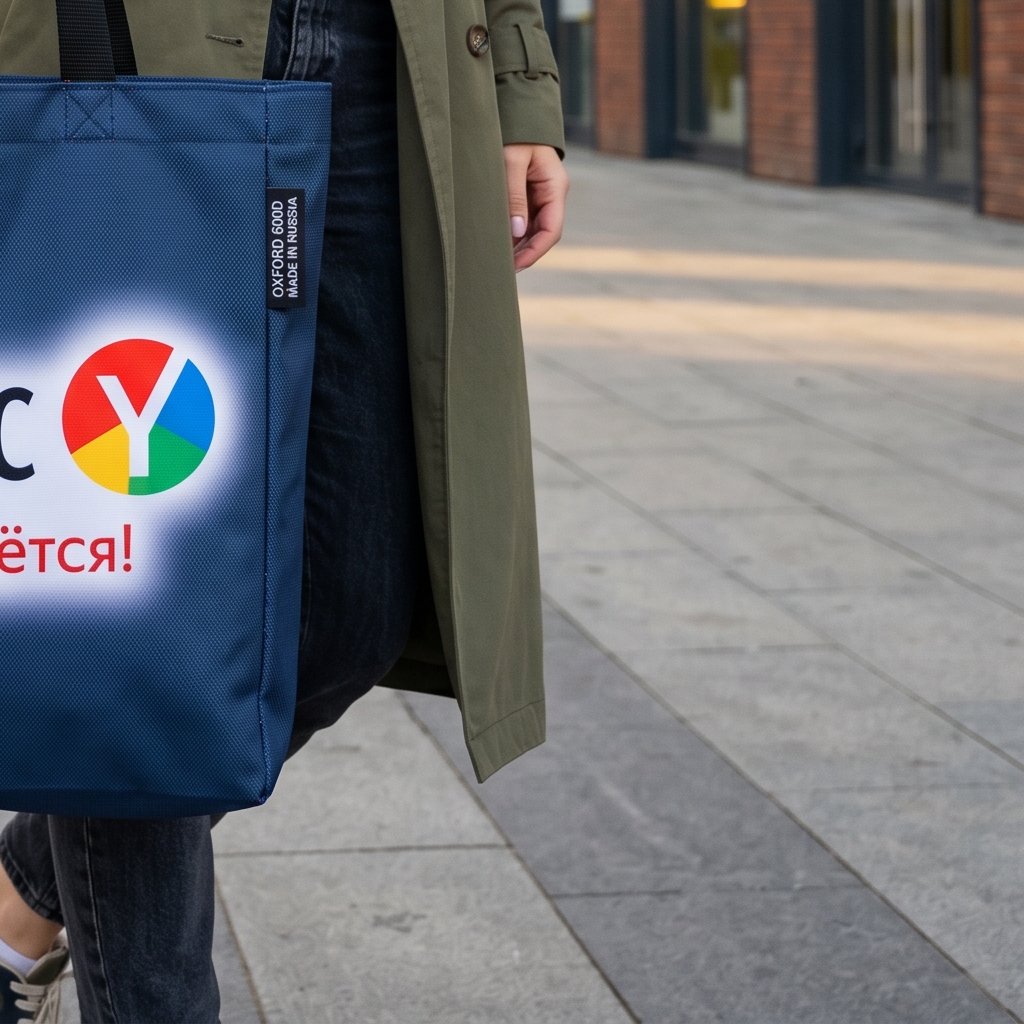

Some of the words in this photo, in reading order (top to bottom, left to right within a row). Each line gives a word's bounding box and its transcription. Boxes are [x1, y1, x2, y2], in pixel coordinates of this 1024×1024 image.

[271, 200, 284, 235] 600D
[271, 238, 284, 298] OXFORD
[286, 246, 298, 259] IN
[286, 262, 299, 298] MADE
